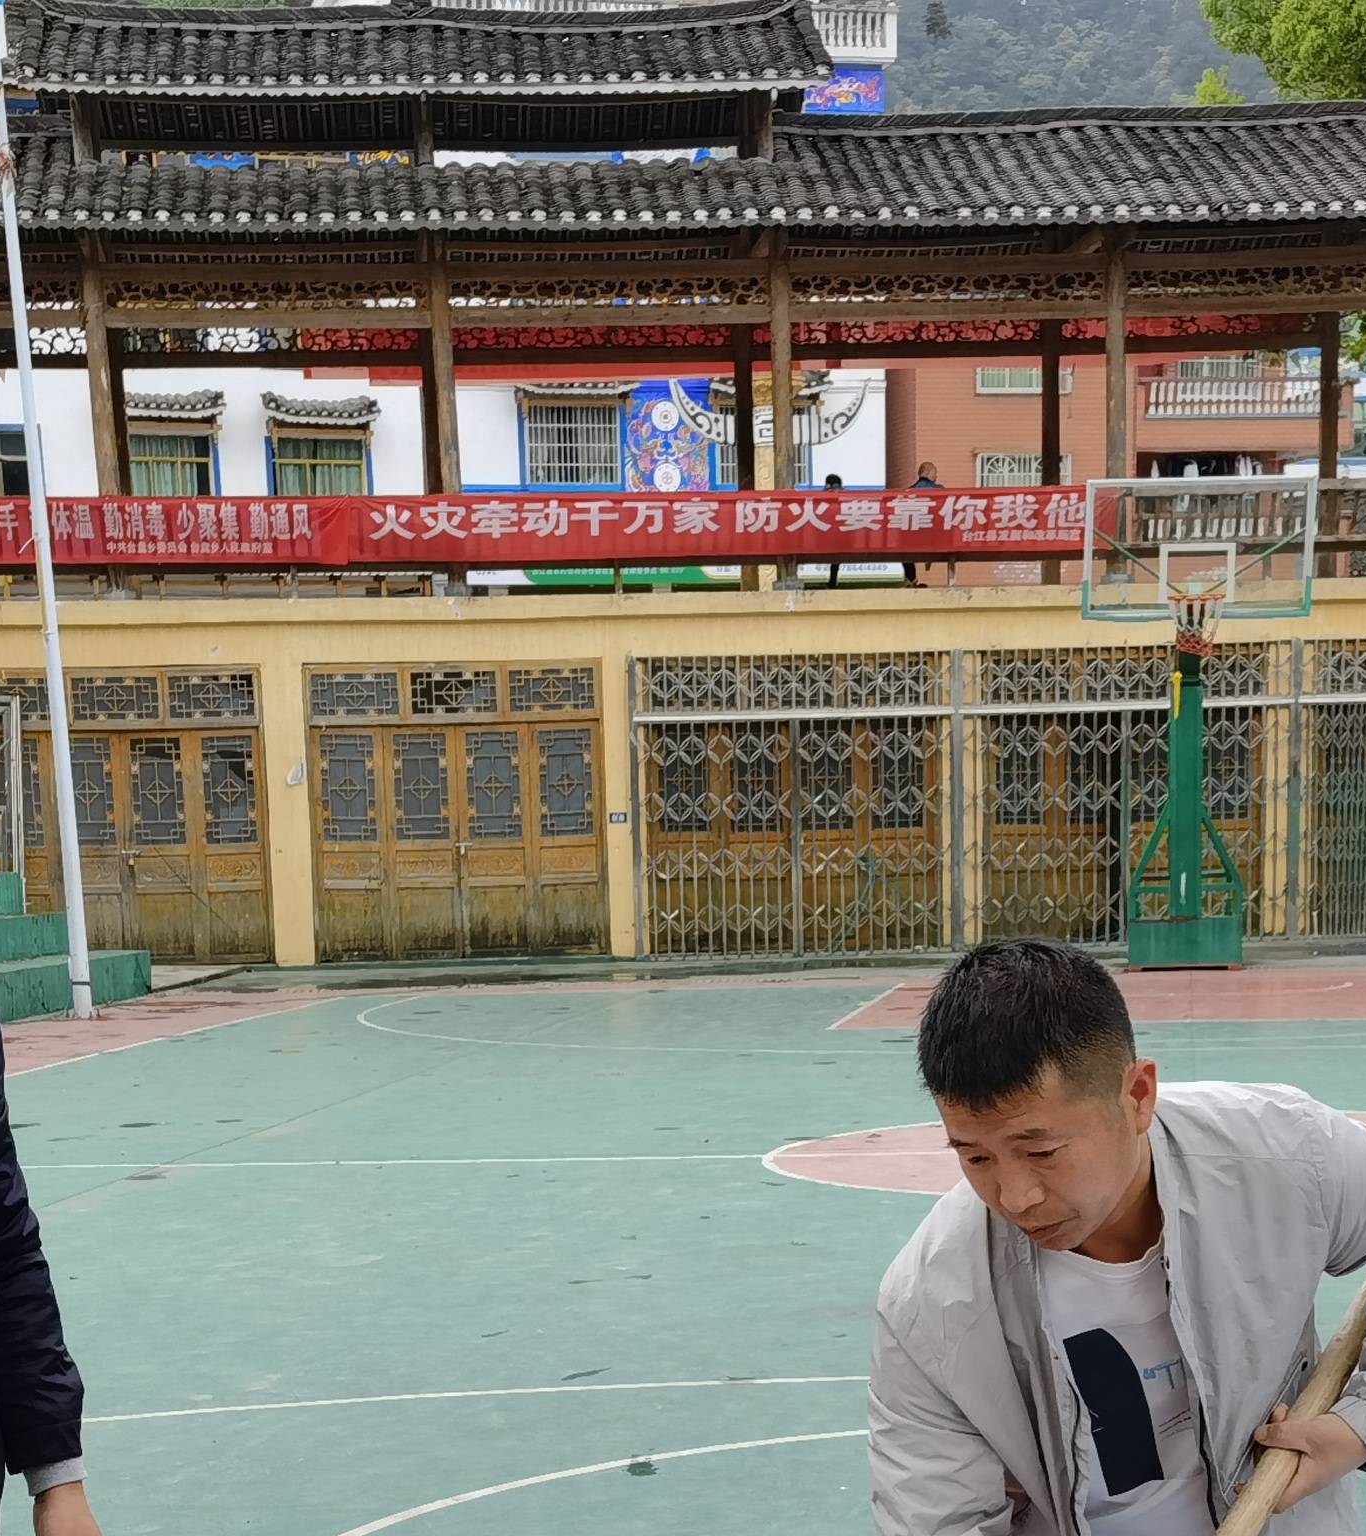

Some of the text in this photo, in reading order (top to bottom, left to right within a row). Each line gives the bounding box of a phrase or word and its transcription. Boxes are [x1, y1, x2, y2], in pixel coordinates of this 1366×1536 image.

[29, 501, 95, 541] 体温
[102, 501, 167, 541] 勤消毒
[176, 501, 240, 541] 少聚集
[248, 502, 313, 541] 勤通风
[368, 492, 1087, 540] 火灾牵动千万家 防火要靠你我他
